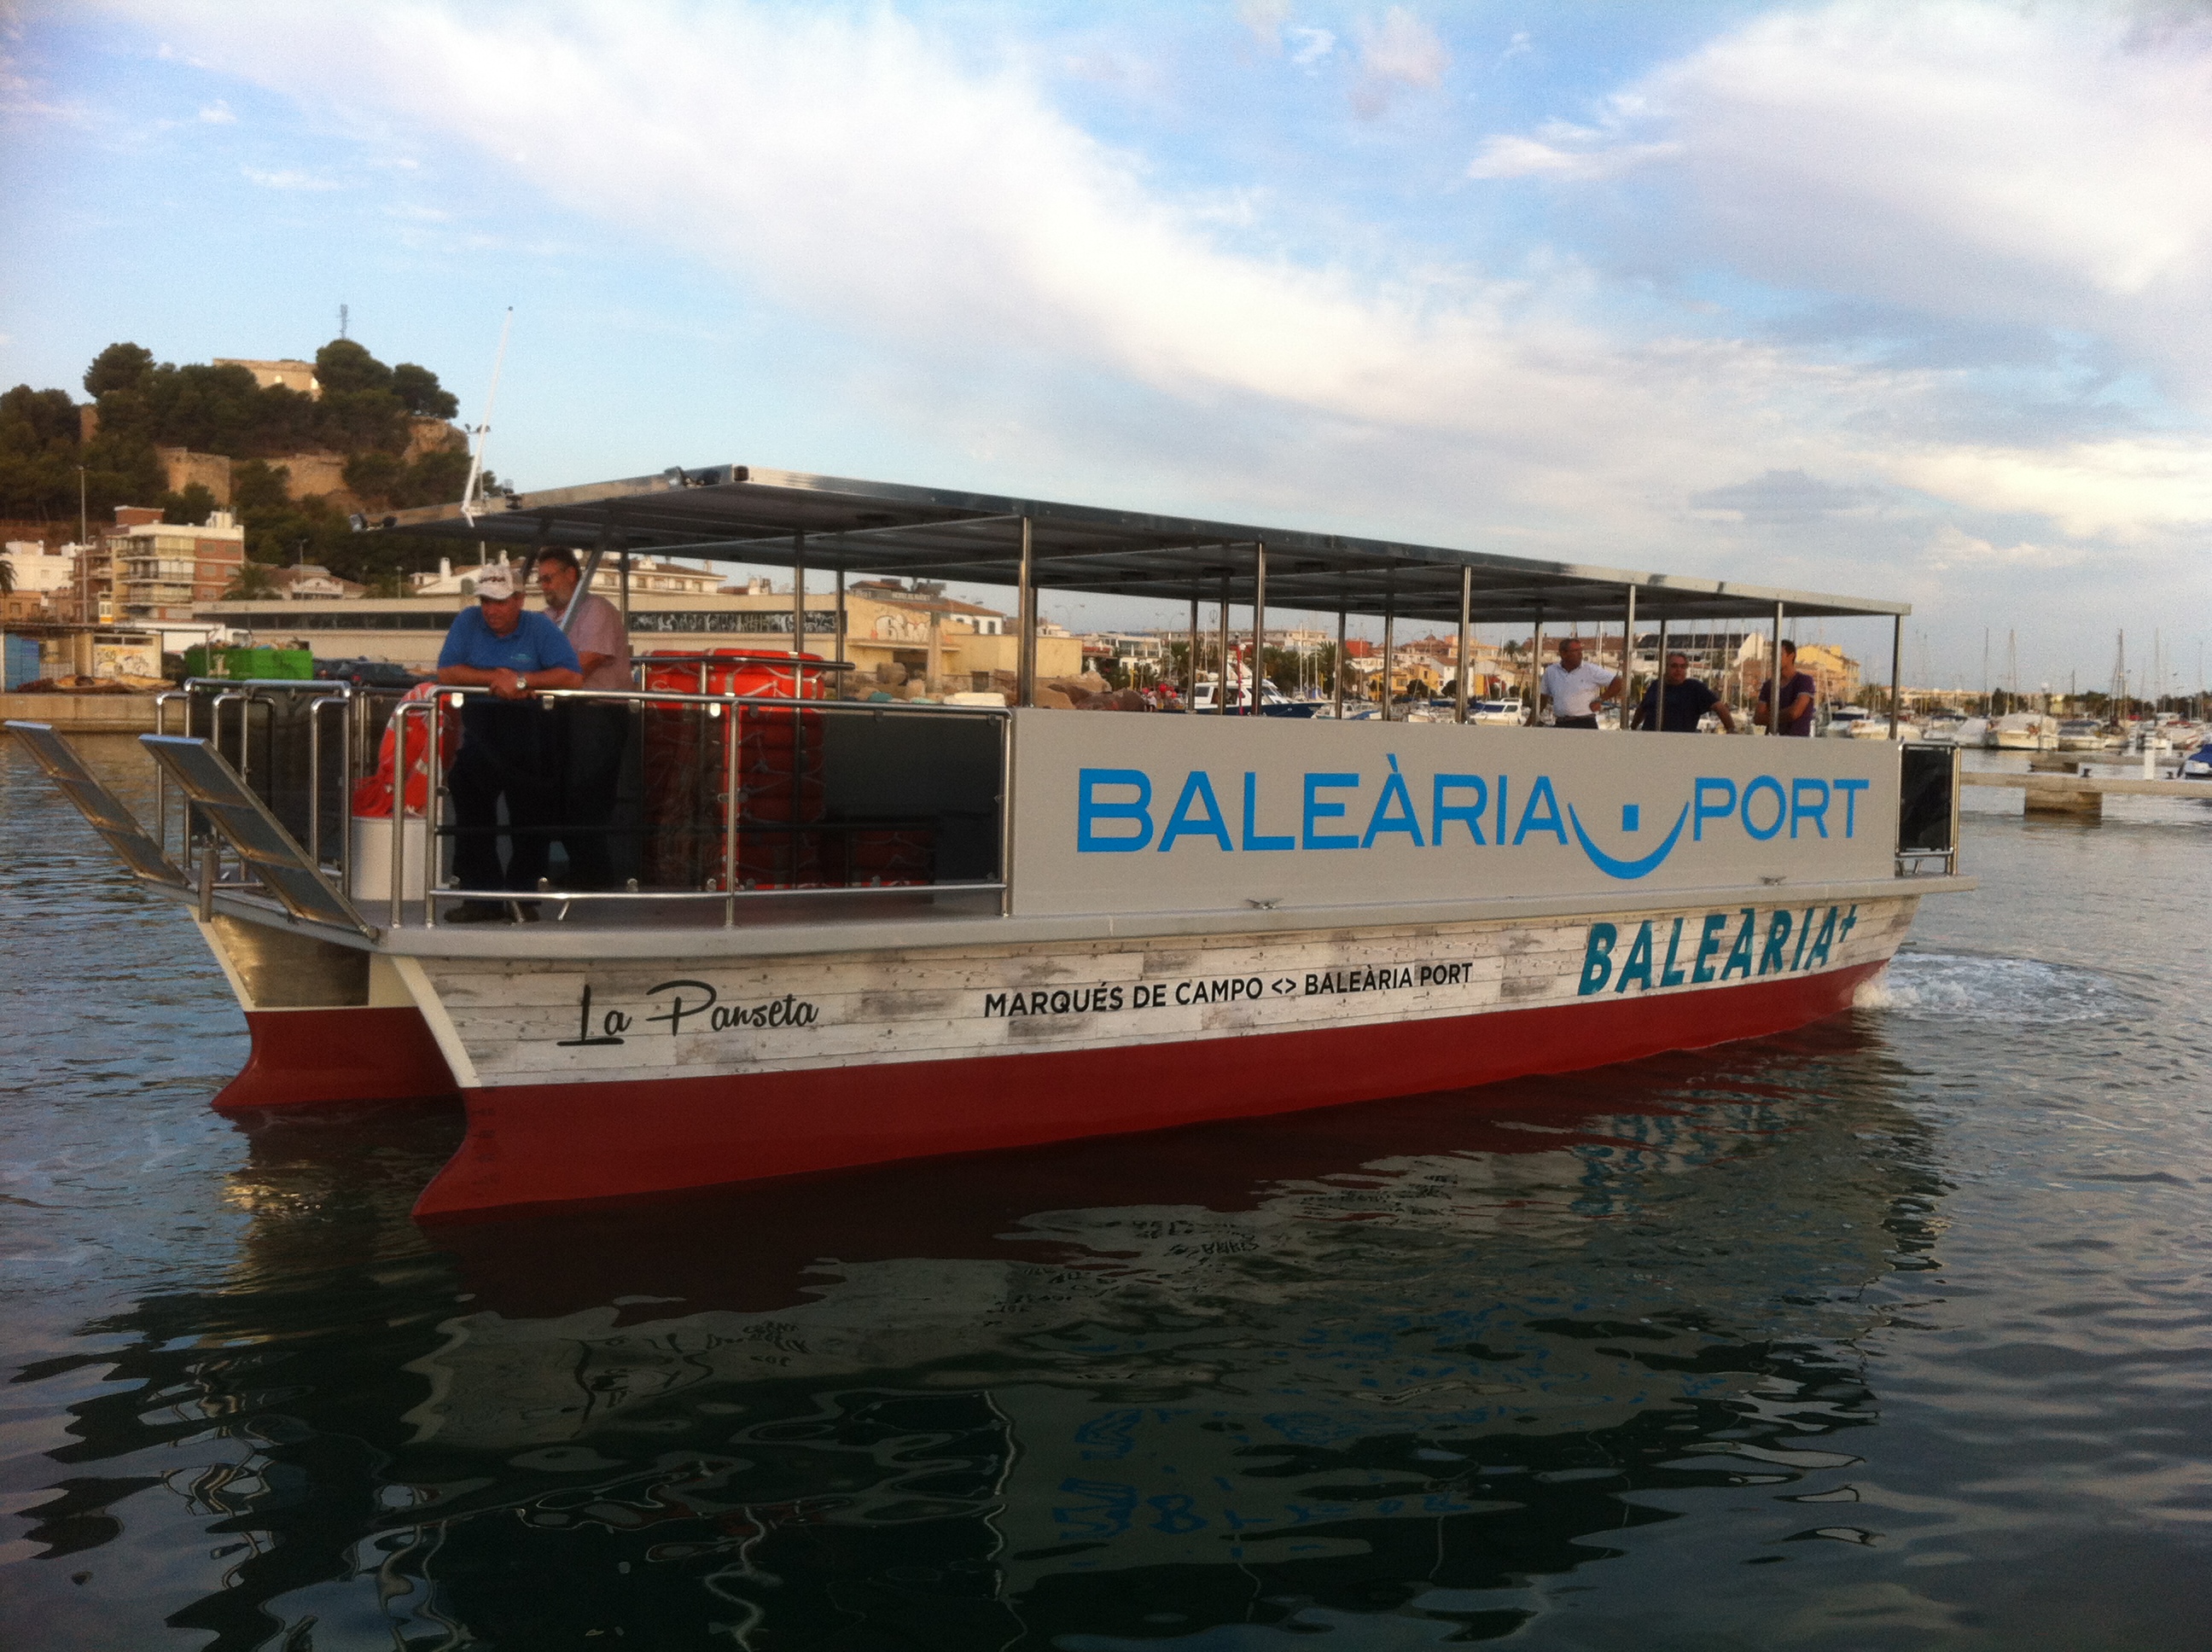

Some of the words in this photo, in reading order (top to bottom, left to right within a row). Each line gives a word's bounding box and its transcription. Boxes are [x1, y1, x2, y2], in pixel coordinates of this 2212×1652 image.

[1076, 753, 1569, 853] BALEÀRIA
[1693, 774, 1870, 841] PORT
[557, 984, 632, 1046] La
[645, 979, 819, 1036] Panseta
[984, 981, 1124, 1018] MARQUÉS
[1132, 985, 1167, 1009] DE
[1174, 977, 1263, 1005] CAMPO
[1305, 964, 1413, 996] BALEÀRIA
[1420, 963, 1473, 986] PORT
